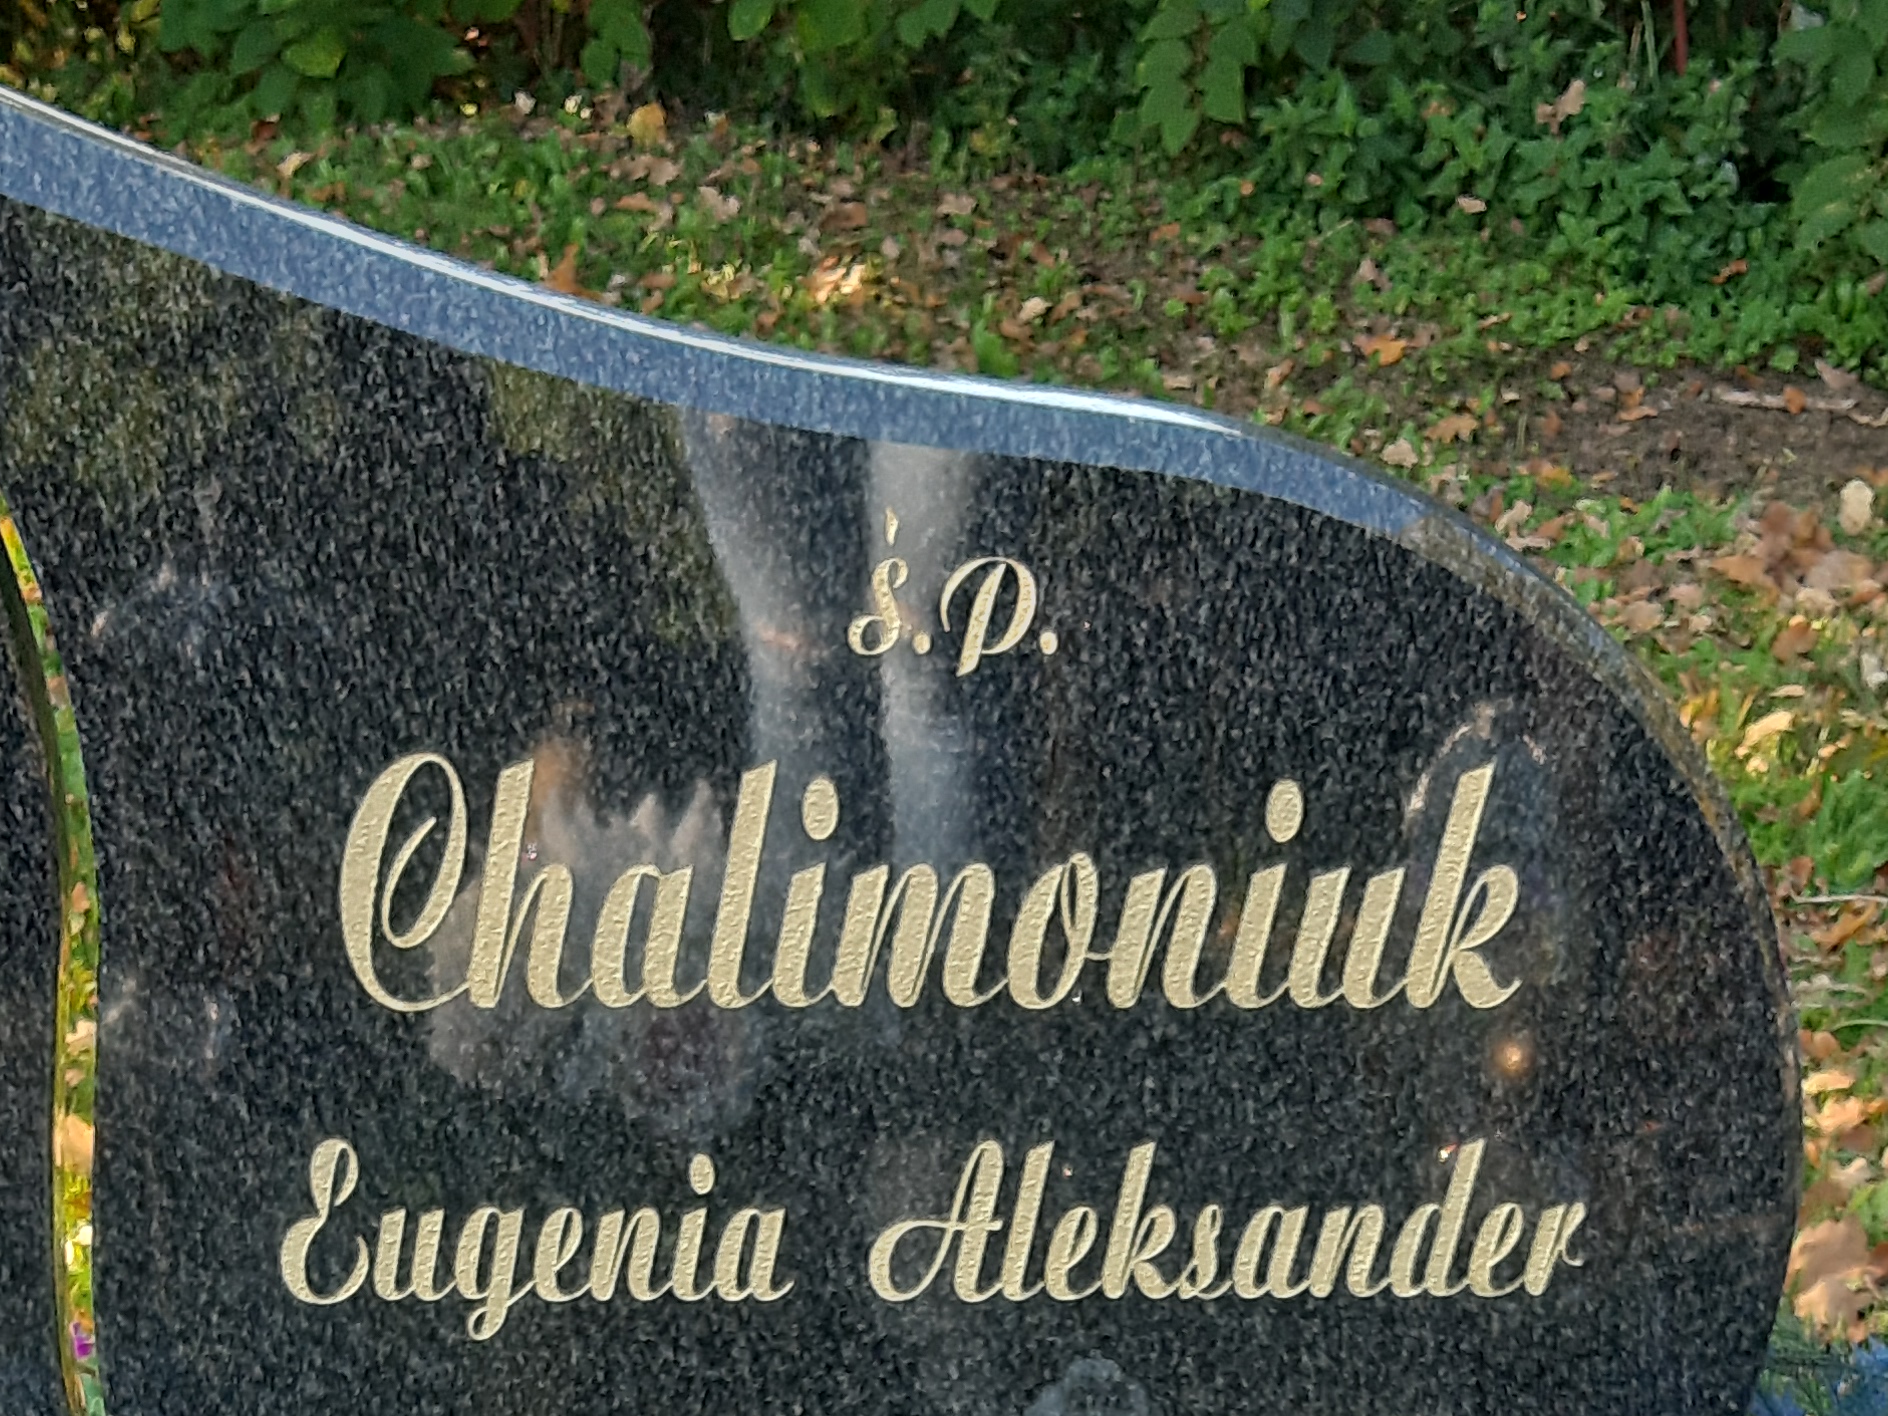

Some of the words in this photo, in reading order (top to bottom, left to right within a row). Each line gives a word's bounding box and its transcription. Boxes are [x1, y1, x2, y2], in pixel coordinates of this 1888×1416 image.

[338, 752, 1523, 1014] Chalimoniuk
[279, 1137, 795, 1342] Eugenia
[867, 1138, 1586, 1303] Aleksander
